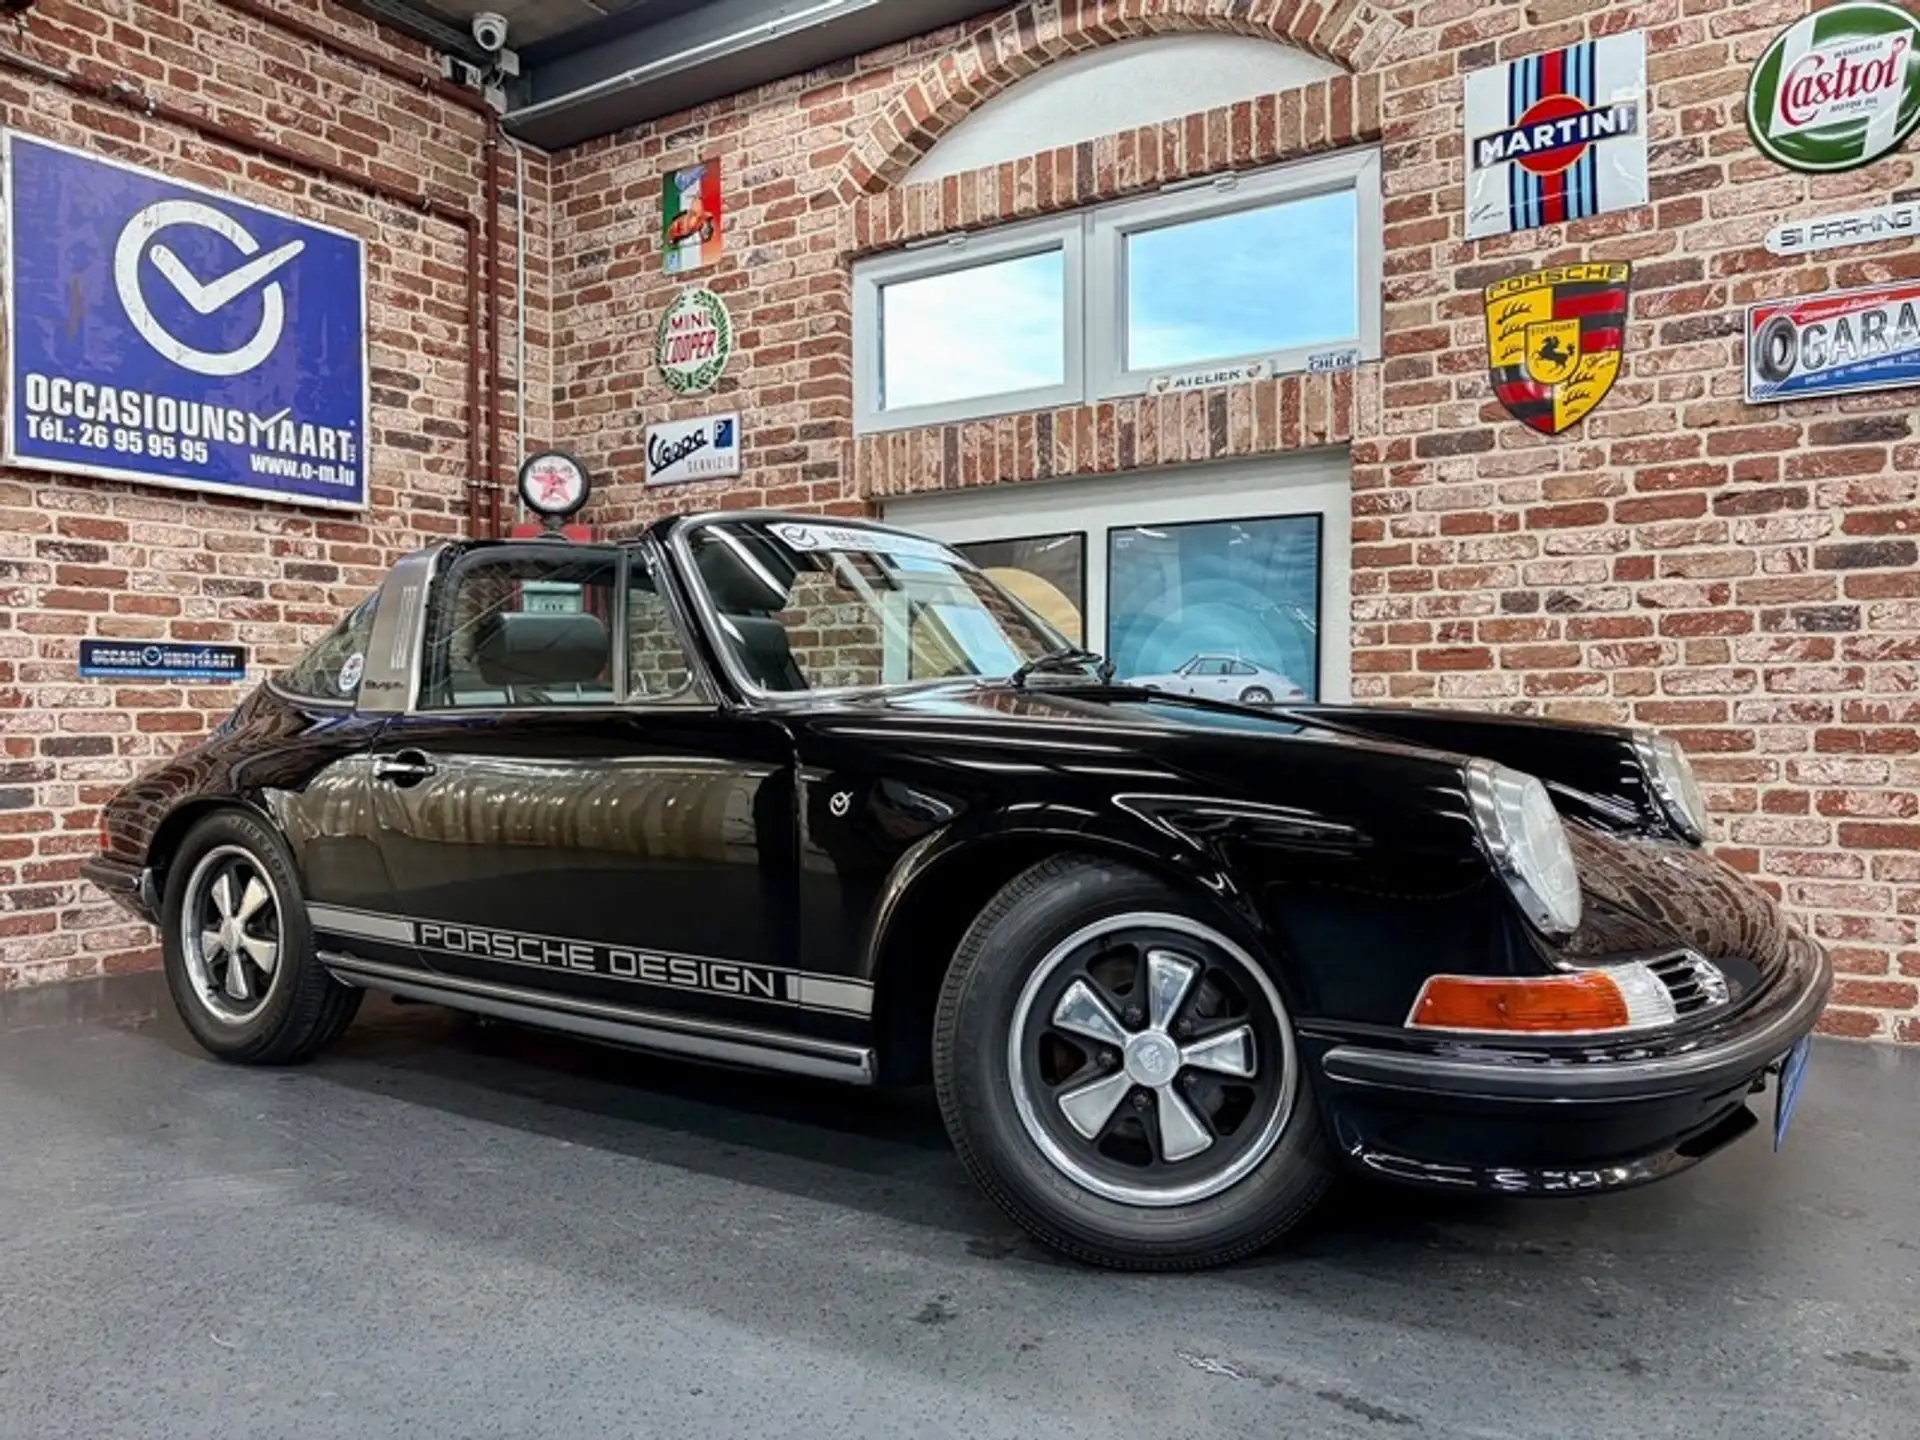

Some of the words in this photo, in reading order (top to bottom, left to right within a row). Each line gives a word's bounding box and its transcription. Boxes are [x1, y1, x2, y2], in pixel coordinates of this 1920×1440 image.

[1780, 36, 1908, 127] Castrol
[1480, 107, 1629, 167] MARTINI
[1489, 263, 1627, 299] PORSCHE
[670, 311, 709, 331] MINI
[664, 329, 717, 365] COOPER
[25, 373, 353, 463] OCCASIOUNSMAART
[25, 414, 75, 444] Tél.:
[79, 422, 109, 450] 26
[113, 428, 143, 455] 95
[148, 434, 176, 460] 95
[180, 439, 208, 465] 95
[250, 453, 355, 487] www.o-m.lu
[648, 427, 709, 476] Vespa
[421, 924, 596, 973] PORSCHE
[608, 949, 776, 999] DESIGN
